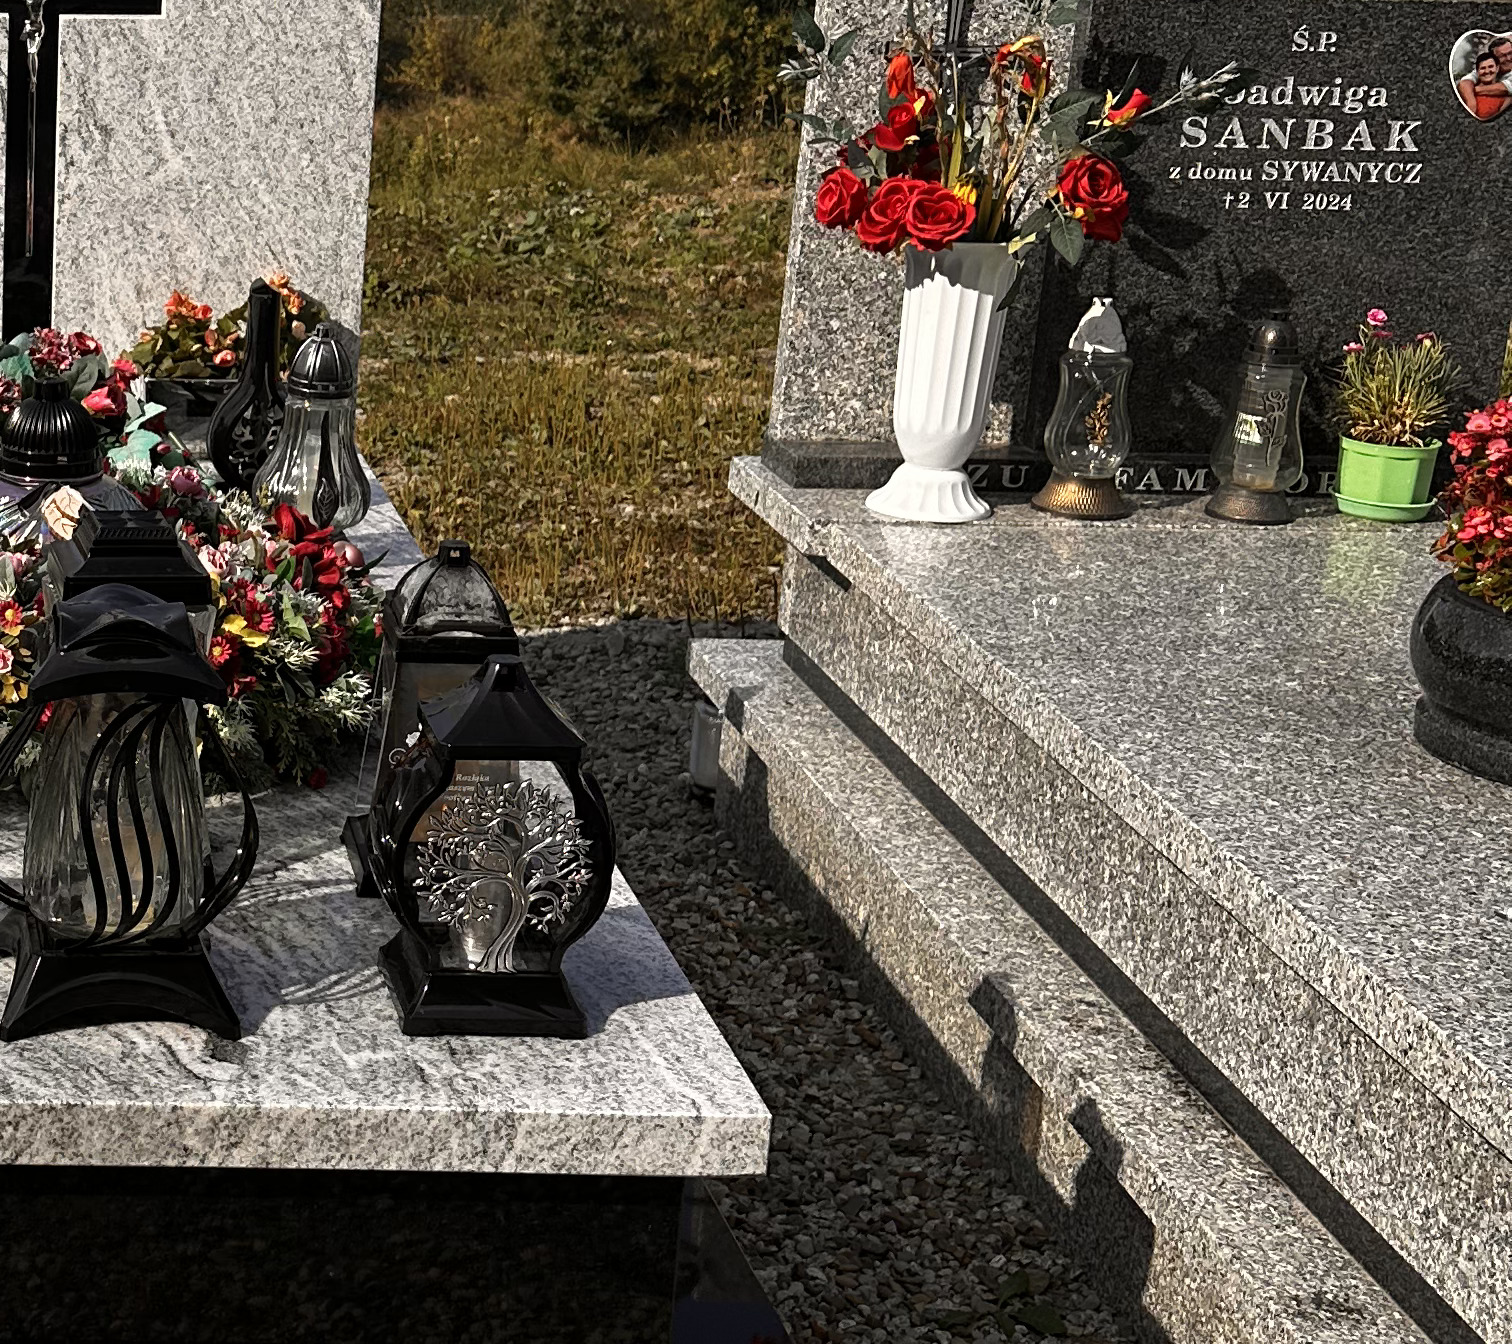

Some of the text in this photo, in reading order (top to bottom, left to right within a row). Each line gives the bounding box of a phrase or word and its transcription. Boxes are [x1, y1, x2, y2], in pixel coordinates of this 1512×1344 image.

[1291, 25, 1338, 53] Ś.P.
[1180, 115, 1422, 152] SANBAK
[1168, 160, 1423, 184] z domu SYWANYCZ
[1264, 192, 1290, 210] VI
[1301, 193, 1353, 211] 2024
[1114, 466, 1209, 492] FAM
